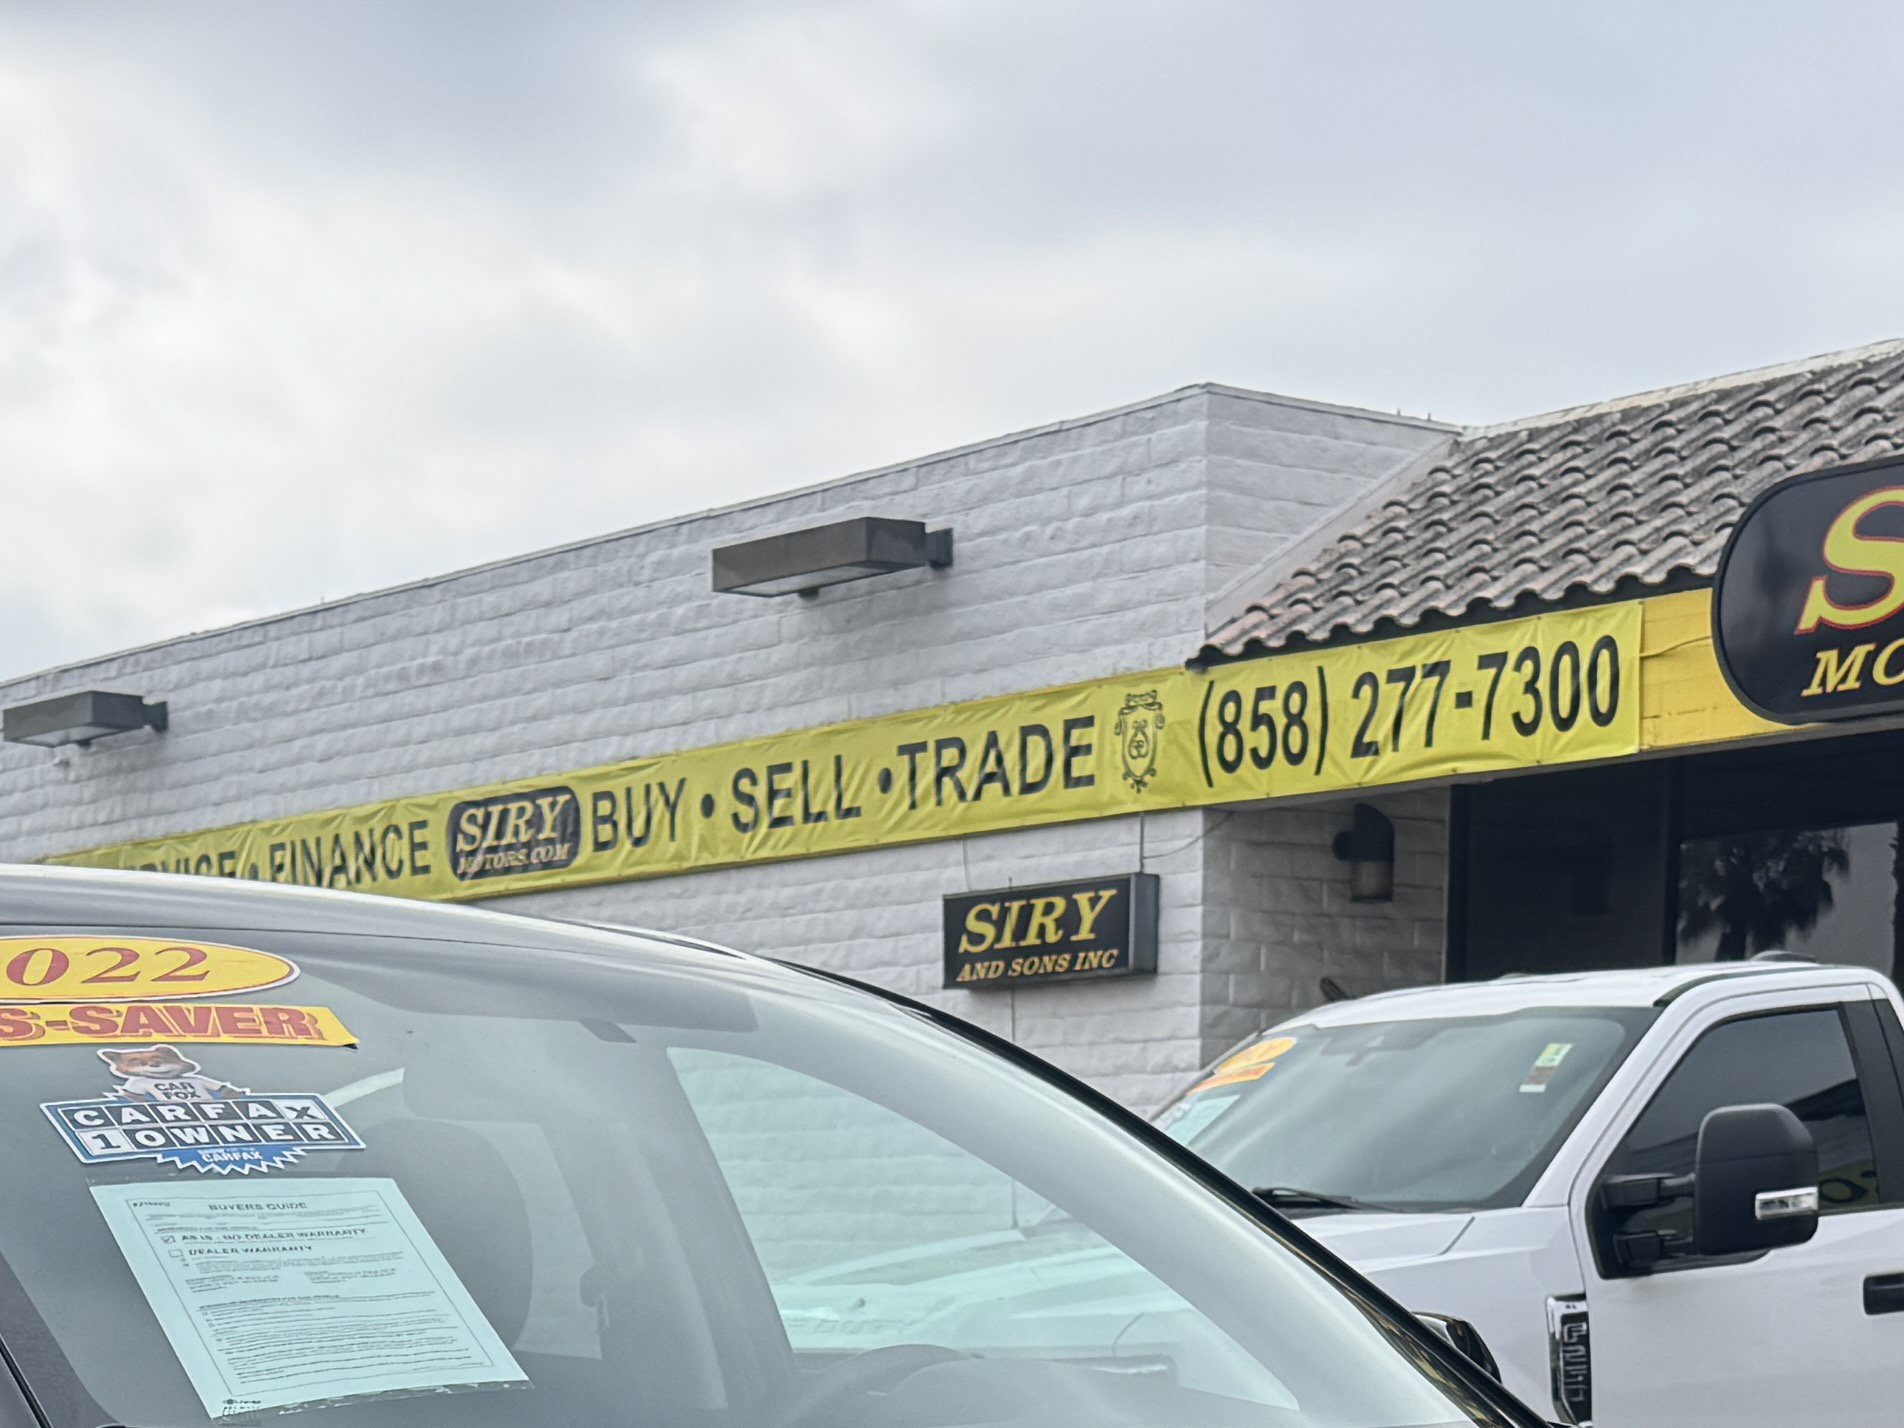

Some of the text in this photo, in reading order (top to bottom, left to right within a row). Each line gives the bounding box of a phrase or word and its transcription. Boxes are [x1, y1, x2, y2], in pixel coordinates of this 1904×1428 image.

[1199, 634, 1620, 788] (858) 277-7300
[592, 715, 1095, 852] BUY SELL TRADE
[455, 795, 572, 853] SIRY
[269, 819, 432, 888] FINANCE
[457, 843, 571, 876] MOTORS.COM
[959, 889, 1118, 953] SIRY
[956, 949, 1119, 982] AND SONS INC
[154, 1082, 195, 1091] CAR
[73, 1102, 323, 1126] CARFAX
[87, 1123, 336, 1150] 1 OWNER
